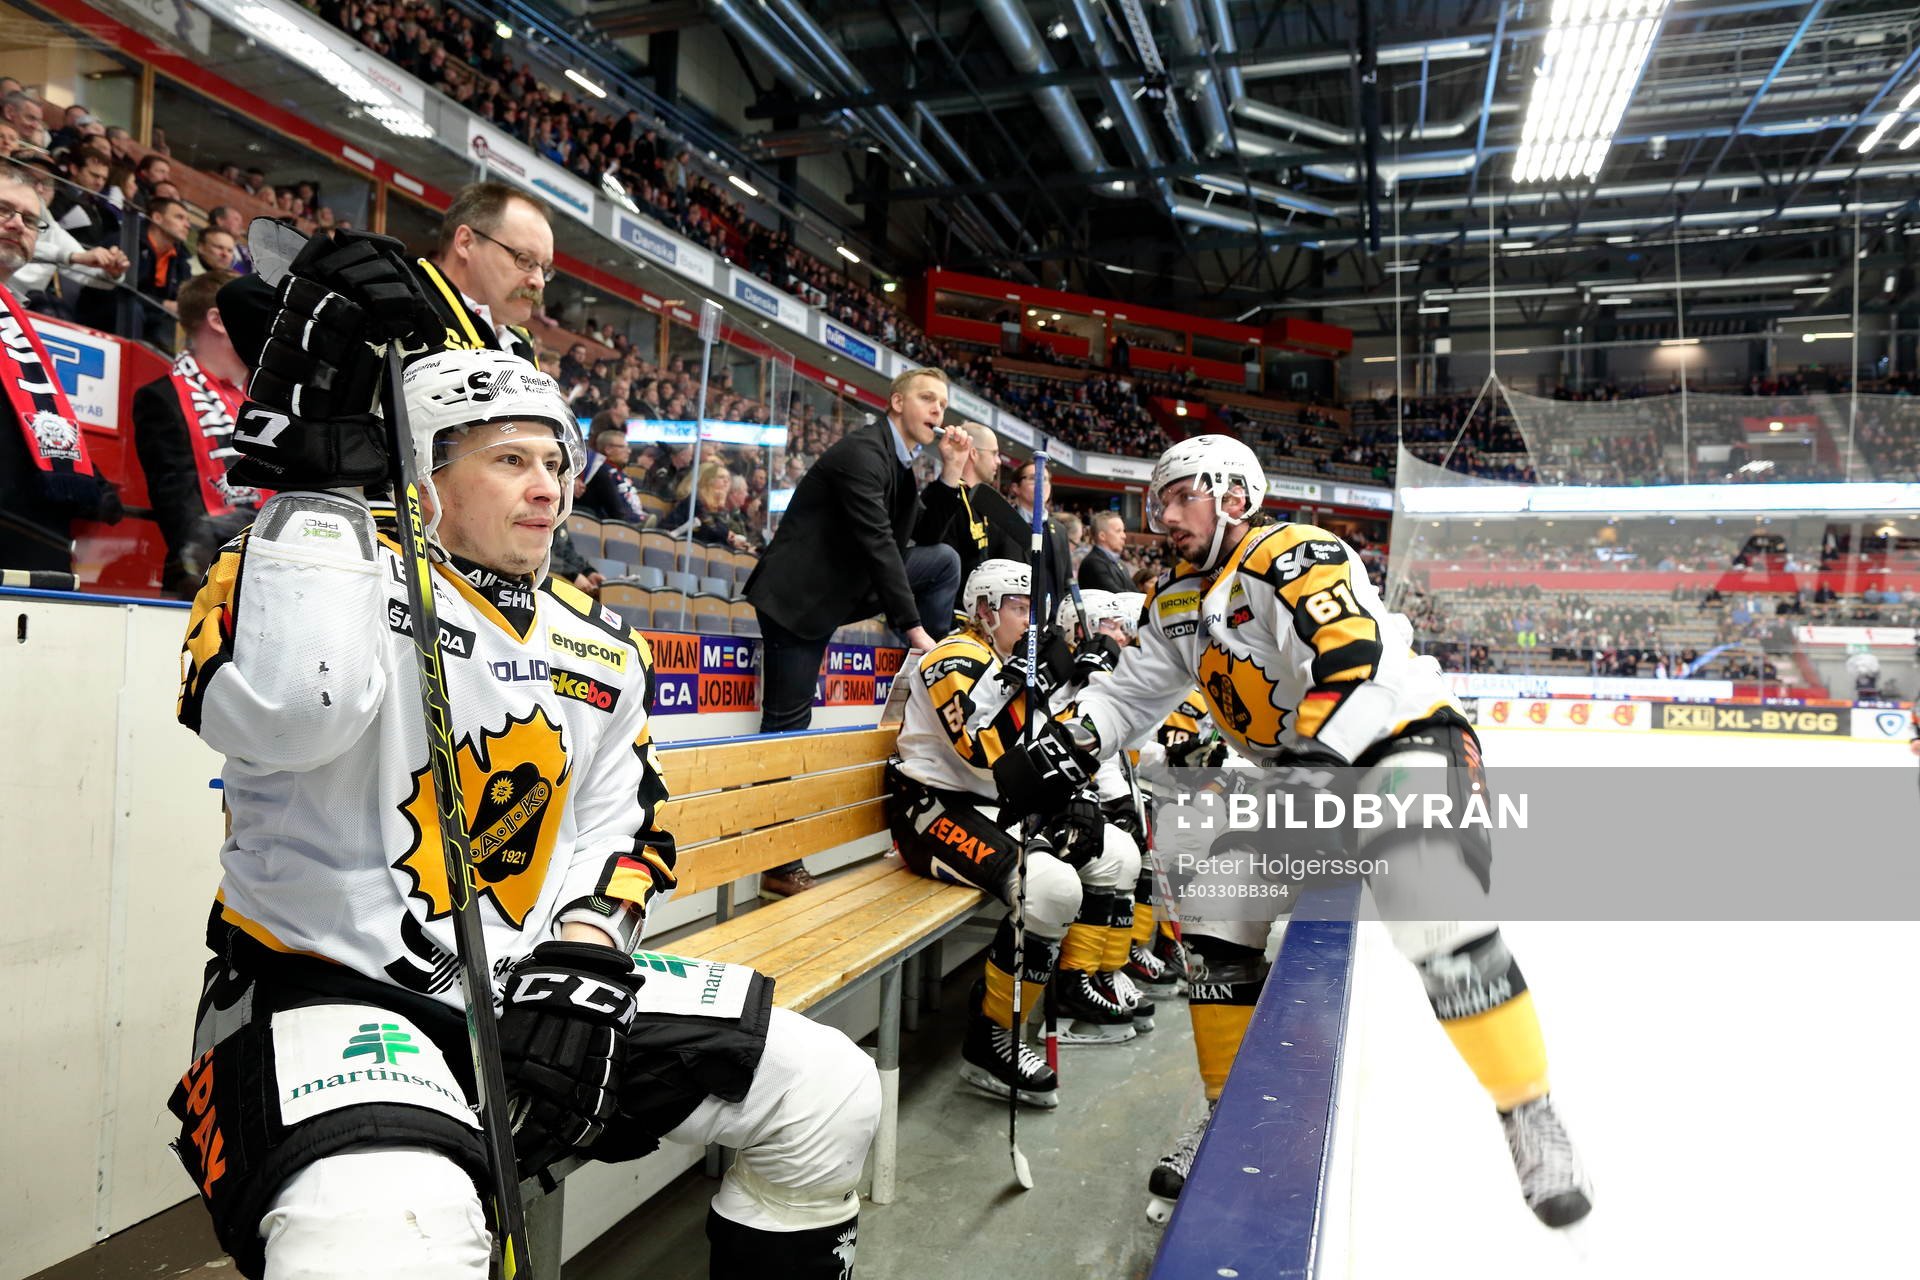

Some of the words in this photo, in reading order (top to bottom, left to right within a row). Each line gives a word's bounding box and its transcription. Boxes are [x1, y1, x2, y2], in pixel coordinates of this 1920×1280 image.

[632, 228, 676, 263] Danske
[744, 287, 778, 317] Danske
[408, 496, 426, 560] CCM
[497, 590, 535, 611] SHL
[1161, 596, 1198, 610] BROKK
[1305, 582, 1361, 625] 61
[389, 605, 466, 654] ŠKDA
[552, 631, 621, 666] engcon
[830, 651, 873, 671] MECA
[1027, 630, 1037, 681] Reebok
[488, 659, 551, 683] OLID
[826, 680, 874, 702] JOBMAN
[1717, 710, 1838, 732] XL-BYGG
[501, 849, 527, 865] 1921
